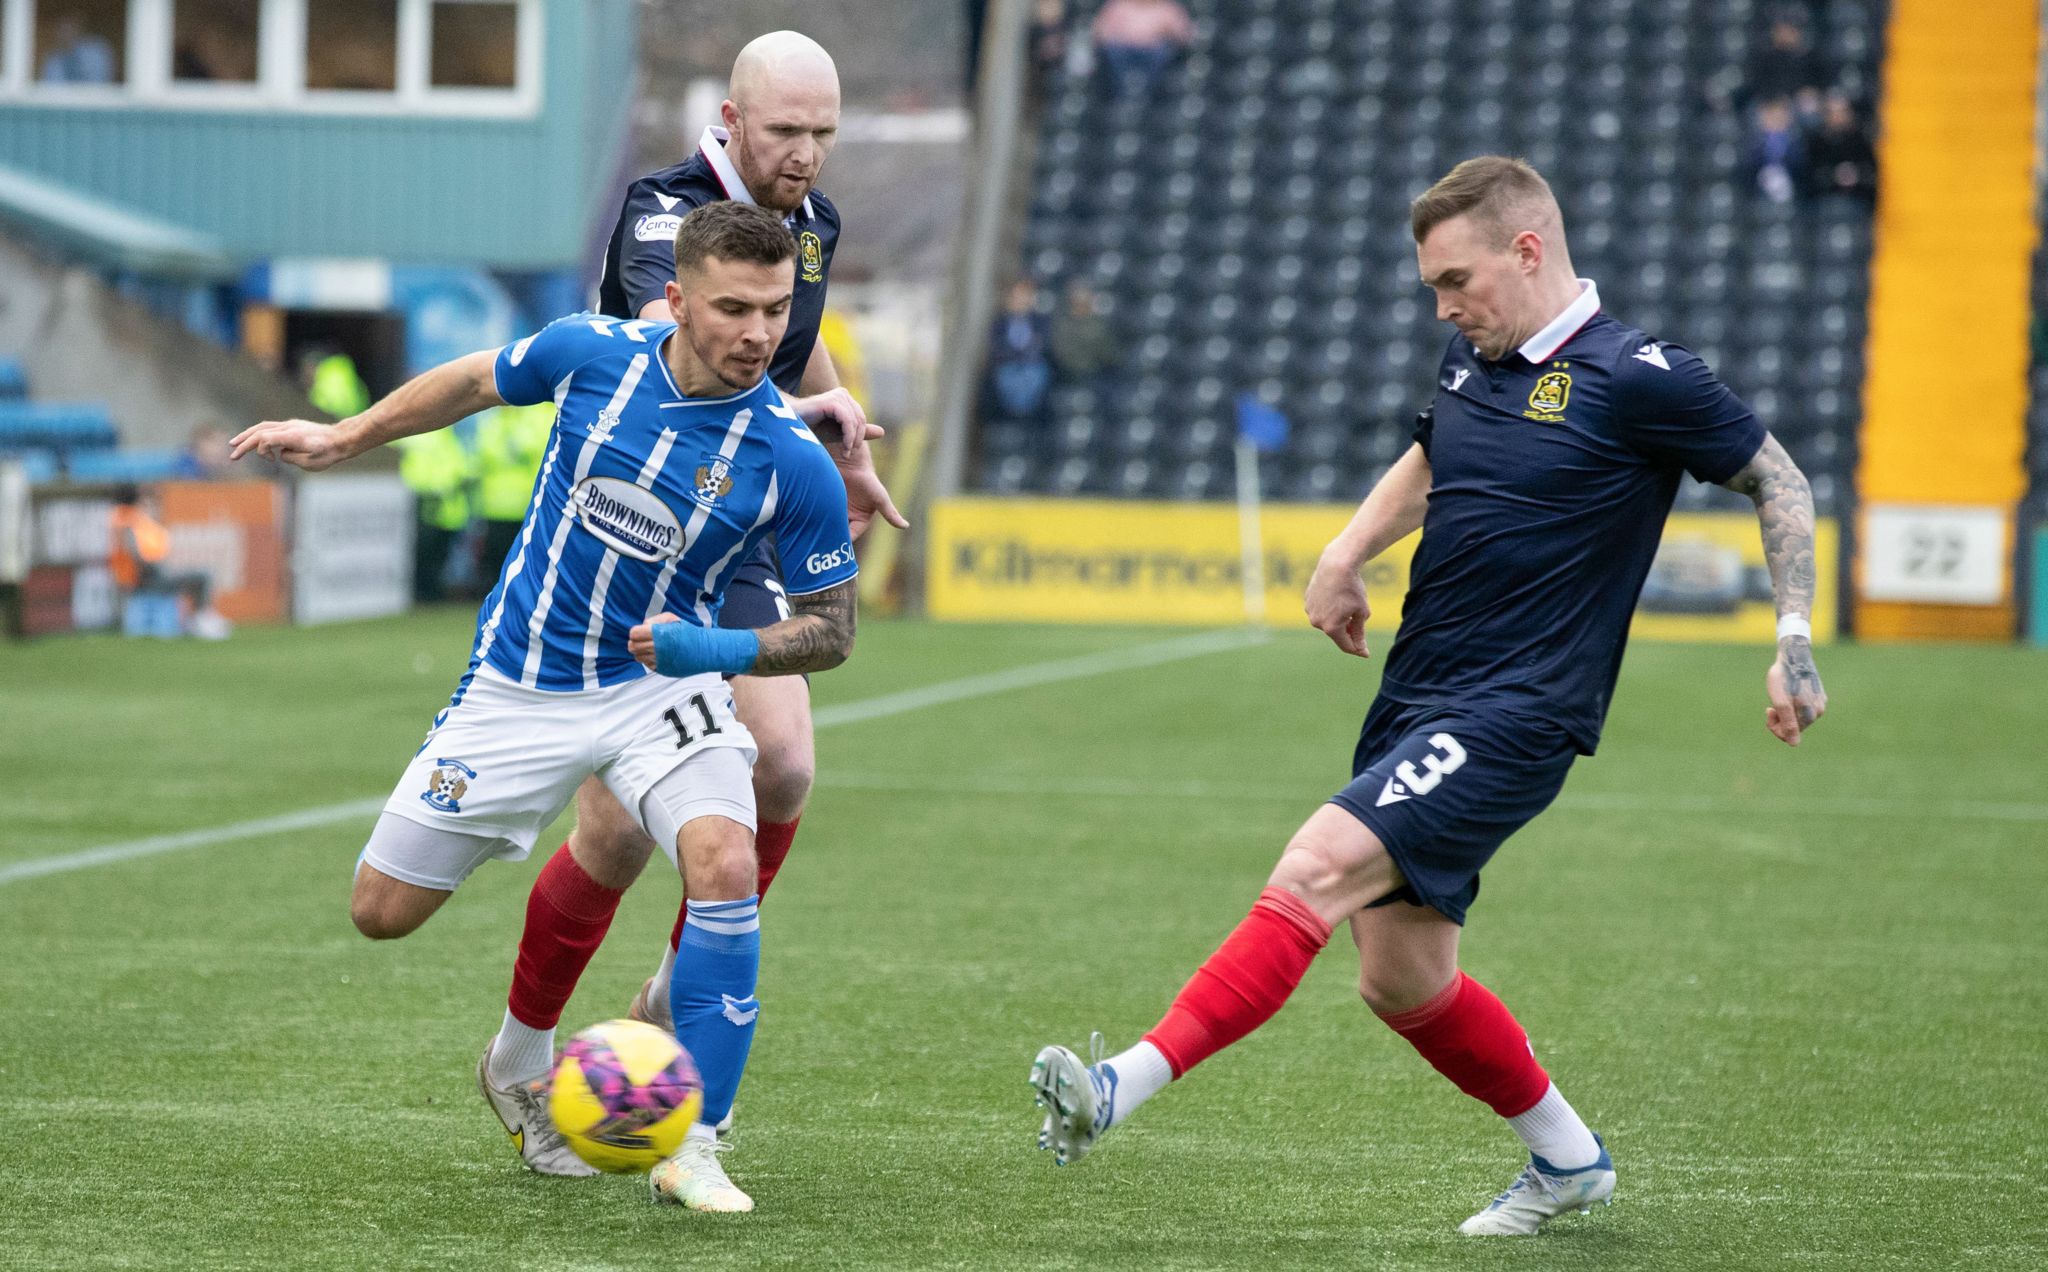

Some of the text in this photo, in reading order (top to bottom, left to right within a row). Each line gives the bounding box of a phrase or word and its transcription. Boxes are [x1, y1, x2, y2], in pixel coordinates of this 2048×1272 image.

[584, 482, 676, 548] BROWNINGS
[614, 527, 652, 551] BAKERS
[1902, 525, 1967, 578] 22
[662, 691, 723, 750] 11
[1395, 732, 1468, 796] 3
